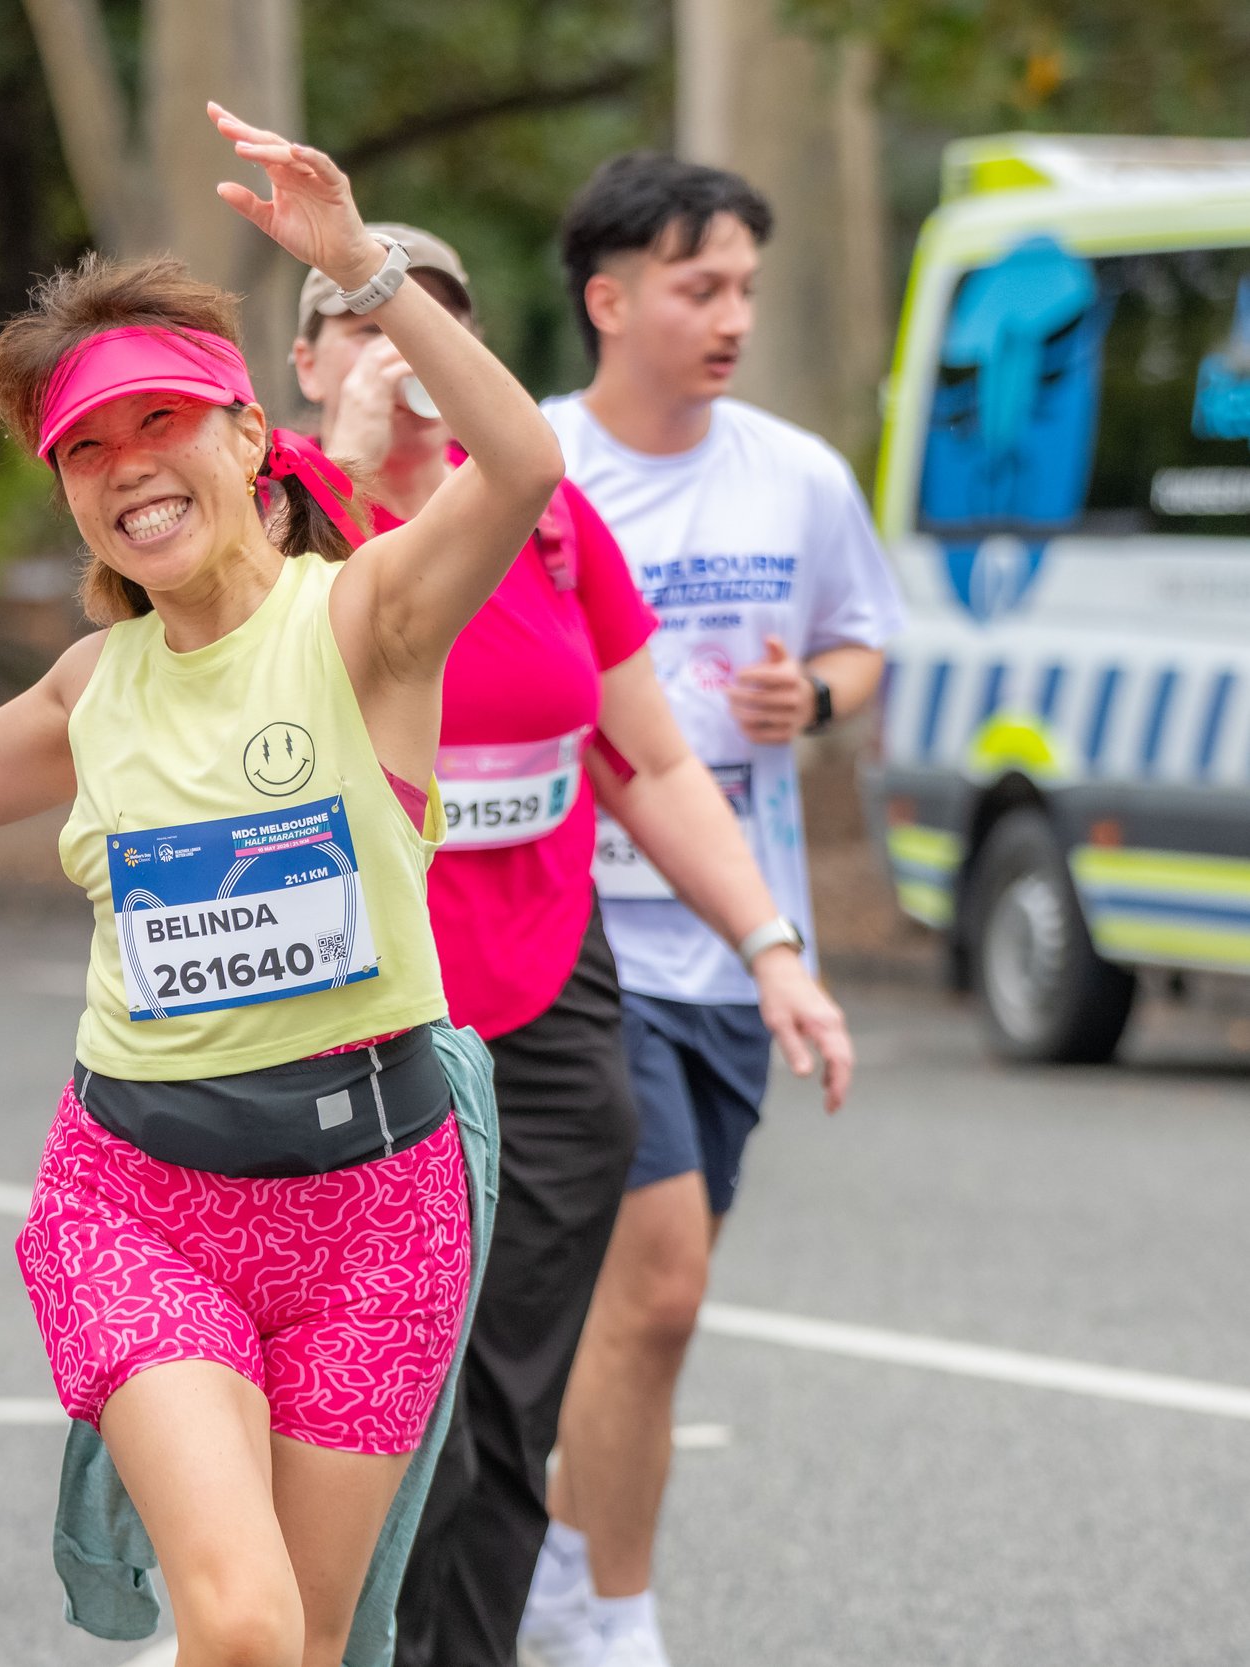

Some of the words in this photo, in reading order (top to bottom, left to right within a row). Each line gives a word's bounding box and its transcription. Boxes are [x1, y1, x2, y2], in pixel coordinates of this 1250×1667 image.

[231, 828, 257, 839] MDC
[259, 813, 329, 835] MELBOURNE
[245, 837, 268, 847] HALF
[268, 826, 319, 843] MARATHON
[285, 872, 308, 885] 21.1
[309, 866, 329, 880] KM
[145, 903, 279, 943] BELINDA
[153, 943, 315, 999] 261640
